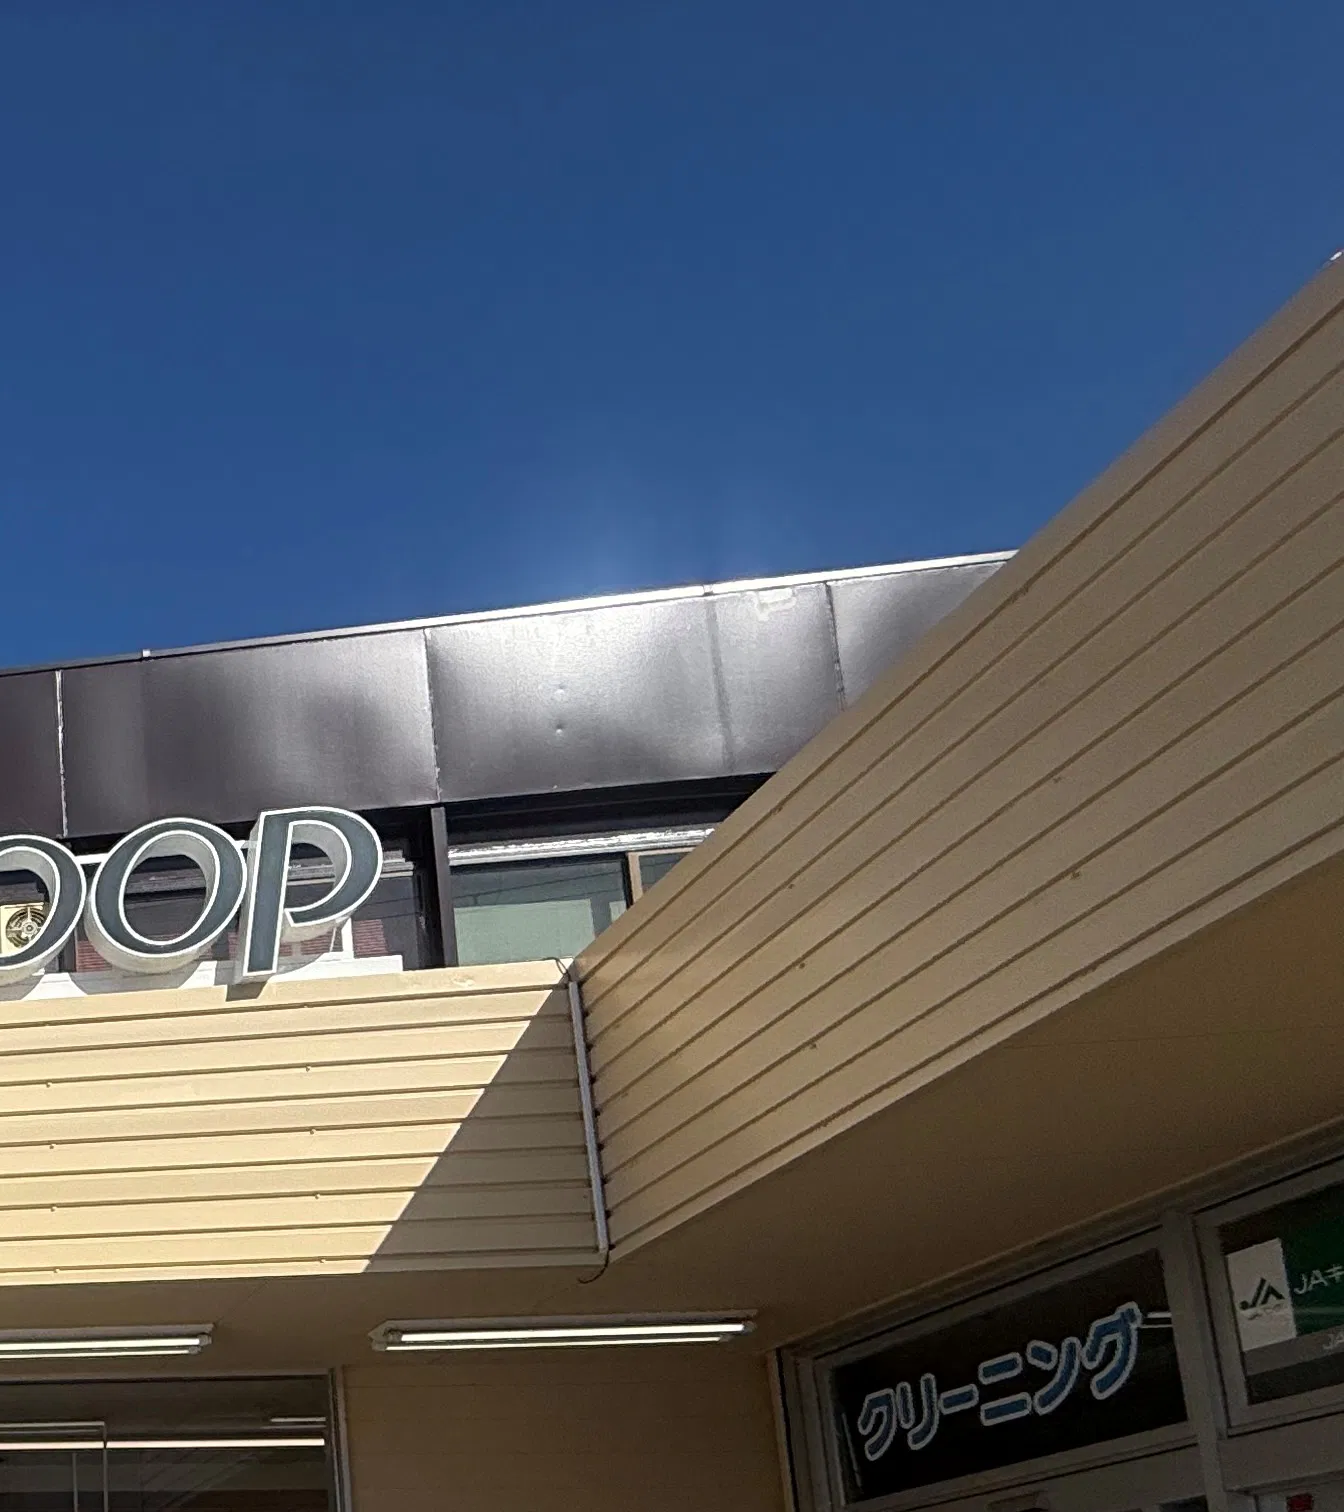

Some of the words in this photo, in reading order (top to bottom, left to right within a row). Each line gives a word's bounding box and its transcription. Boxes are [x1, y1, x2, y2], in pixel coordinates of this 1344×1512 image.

[856, 1300, 1143, 1461] クリーニング
